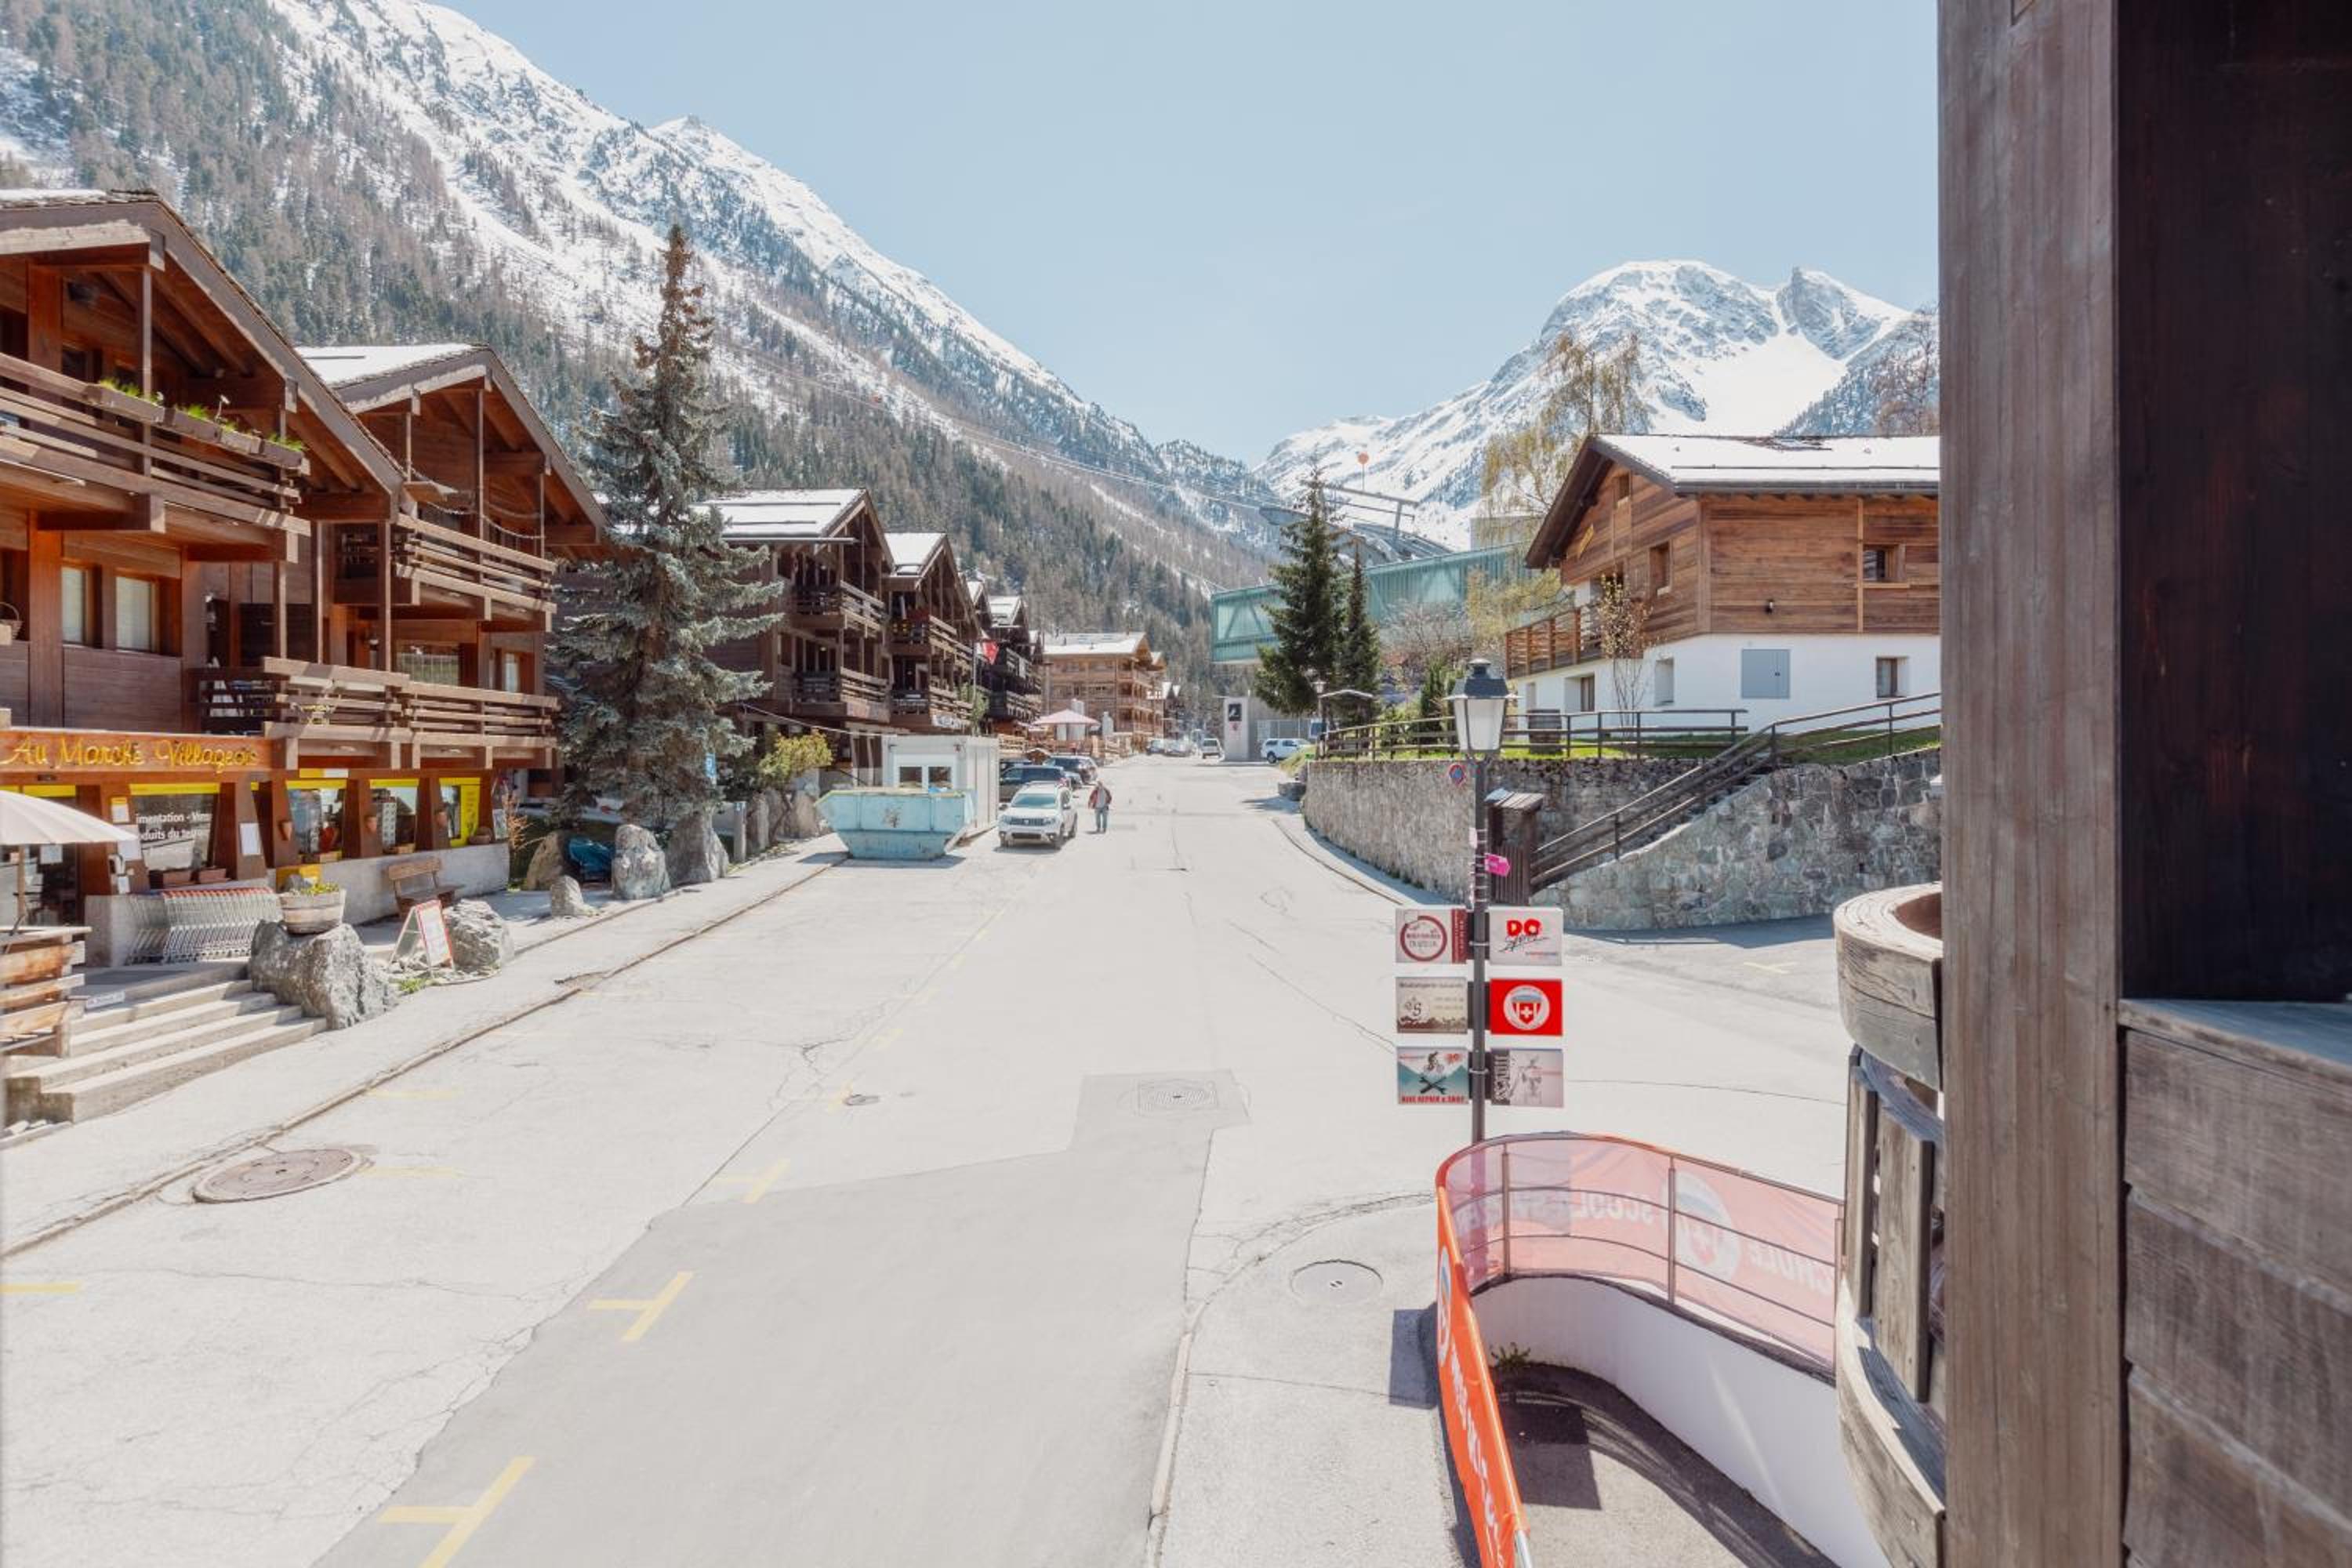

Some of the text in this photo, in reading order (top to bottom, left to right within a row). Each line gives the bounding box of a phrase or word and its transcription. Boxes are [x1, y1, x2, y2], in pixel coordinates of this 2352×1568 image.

[1, 736, 48, 765] Au
[155, 739, 258, 773] Villageois
[1506, 918, 1542, 937] DO
